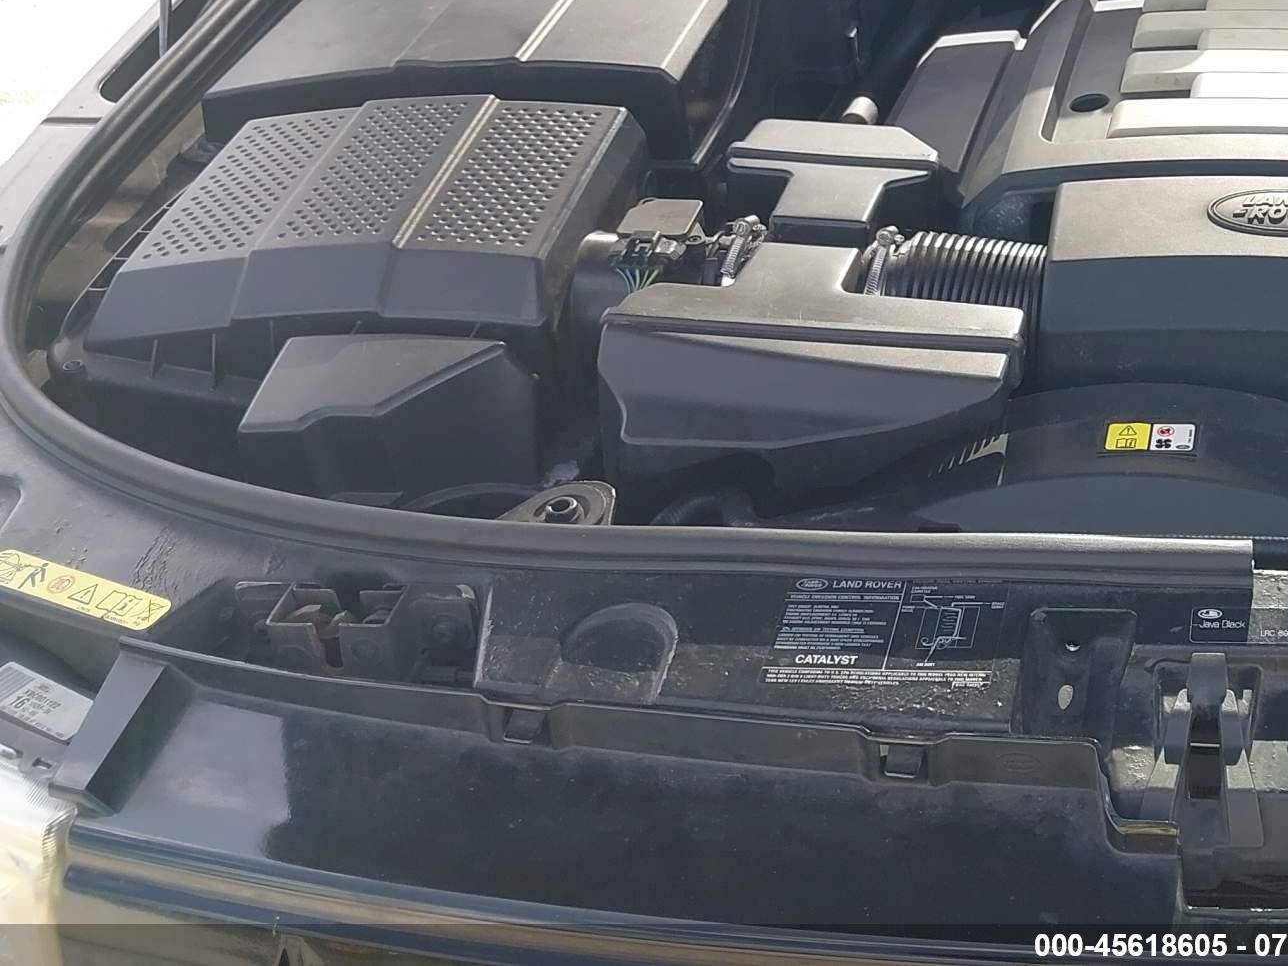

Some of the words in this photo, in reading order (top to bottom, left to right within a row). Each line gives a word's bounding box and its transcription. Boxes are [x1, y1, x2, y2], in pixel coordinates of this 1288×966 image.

[832, 580, 862, 589] LAND
[864, 580, 902, 589] ROVER
[1200, 620, 1220, 629] Java
[1222, 619, 1246, 629] Black
[795, 654, 859, 665] CATALYST
